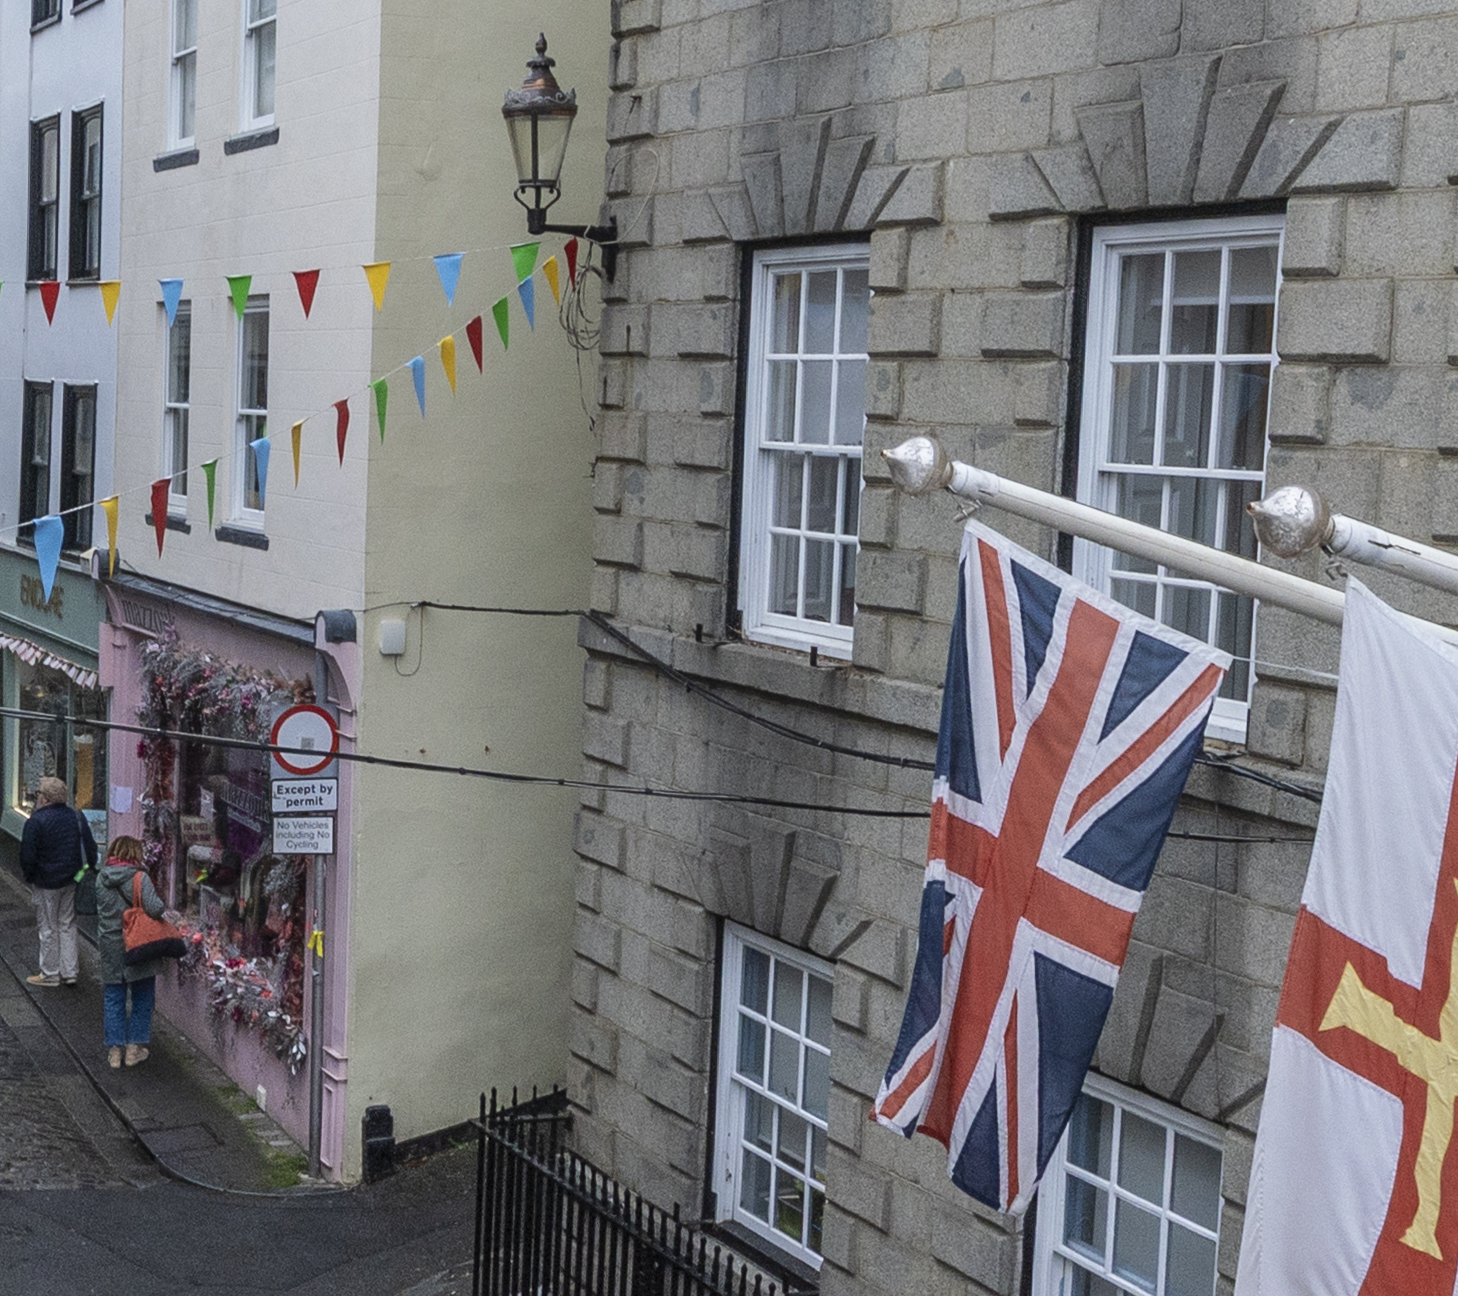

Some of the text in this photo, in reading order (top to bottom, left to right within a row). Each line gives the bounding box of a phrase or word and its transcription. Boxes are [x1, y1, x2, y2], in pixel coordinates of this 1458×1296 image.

[276, 783, 333, 795] Except by
[286, 796, 324, 808] permit
[277, 821, 329, 830] No Vehicles
[317, 831, 330, 839] No
[286, 840, 319, 850] Cycling
